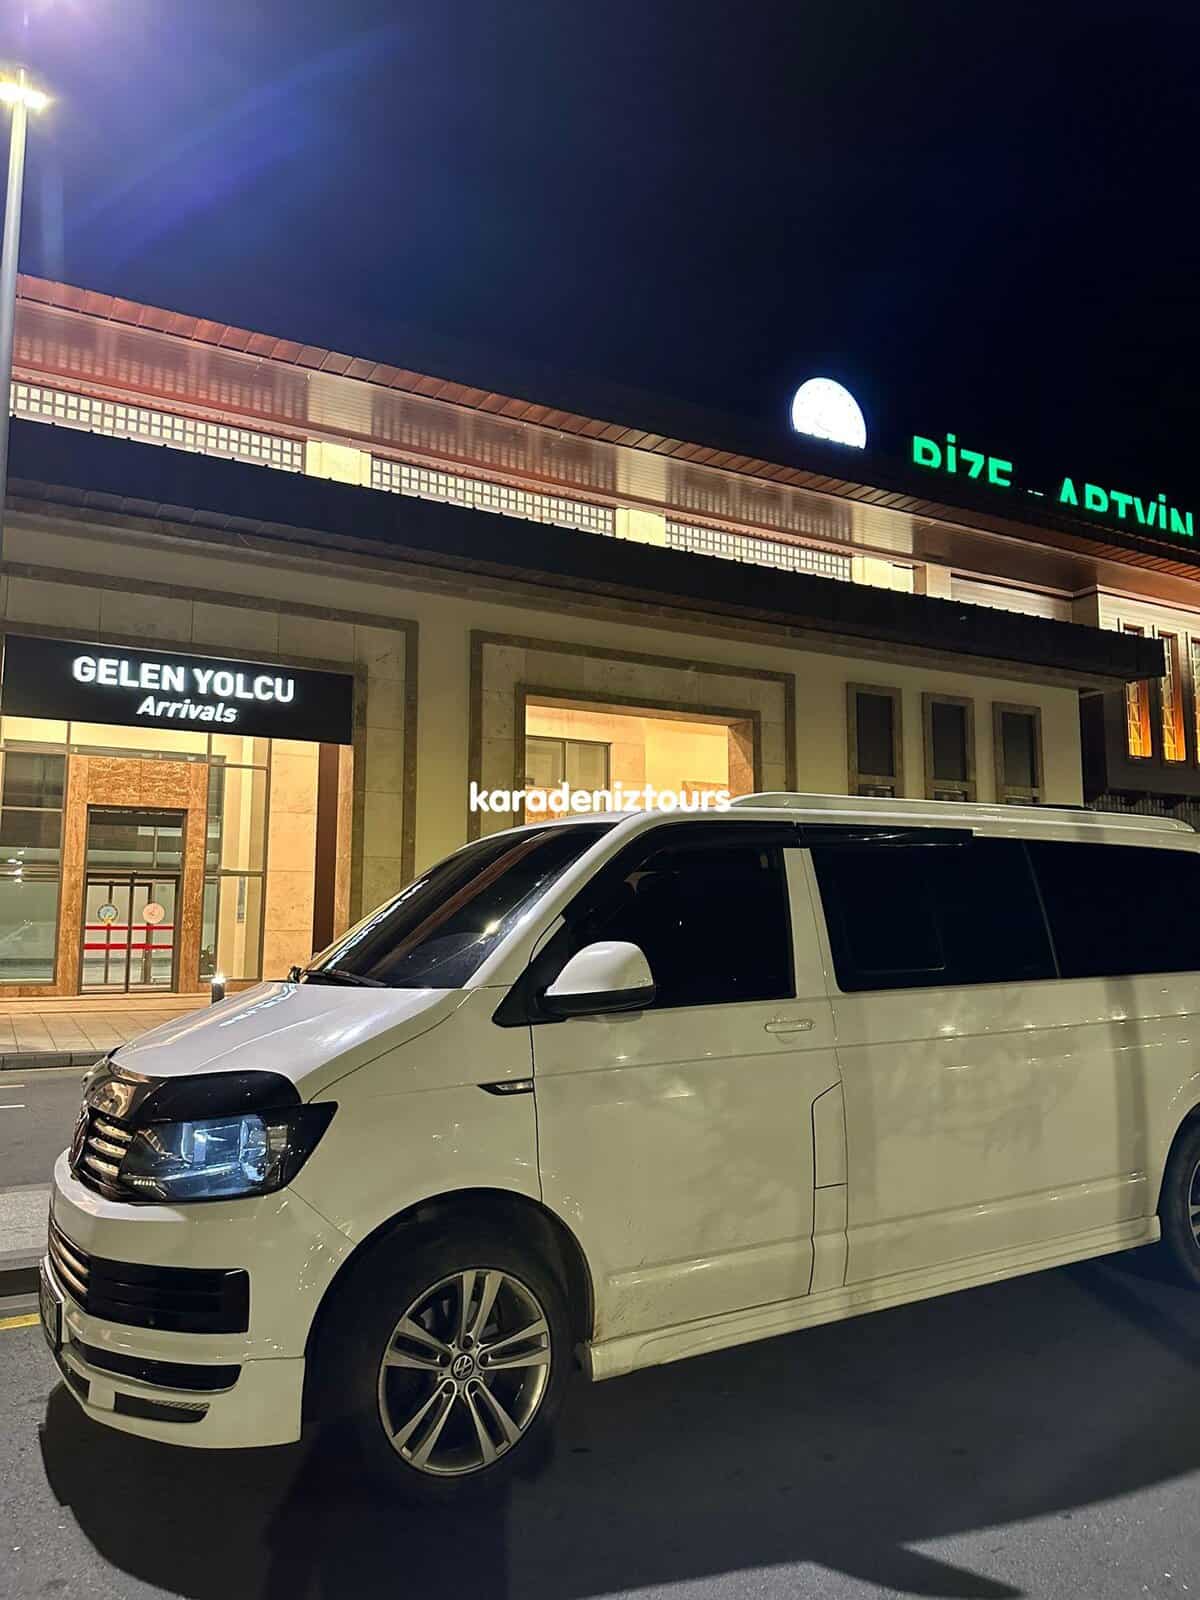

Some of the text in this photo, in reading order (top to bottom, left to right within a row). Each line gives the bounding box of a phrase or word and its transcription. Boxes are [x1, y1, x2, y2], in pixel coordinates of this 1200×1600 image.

[72, 655, 294, 703] GELEN YOLCU
[136, 695, 238, 723] Arrivals
